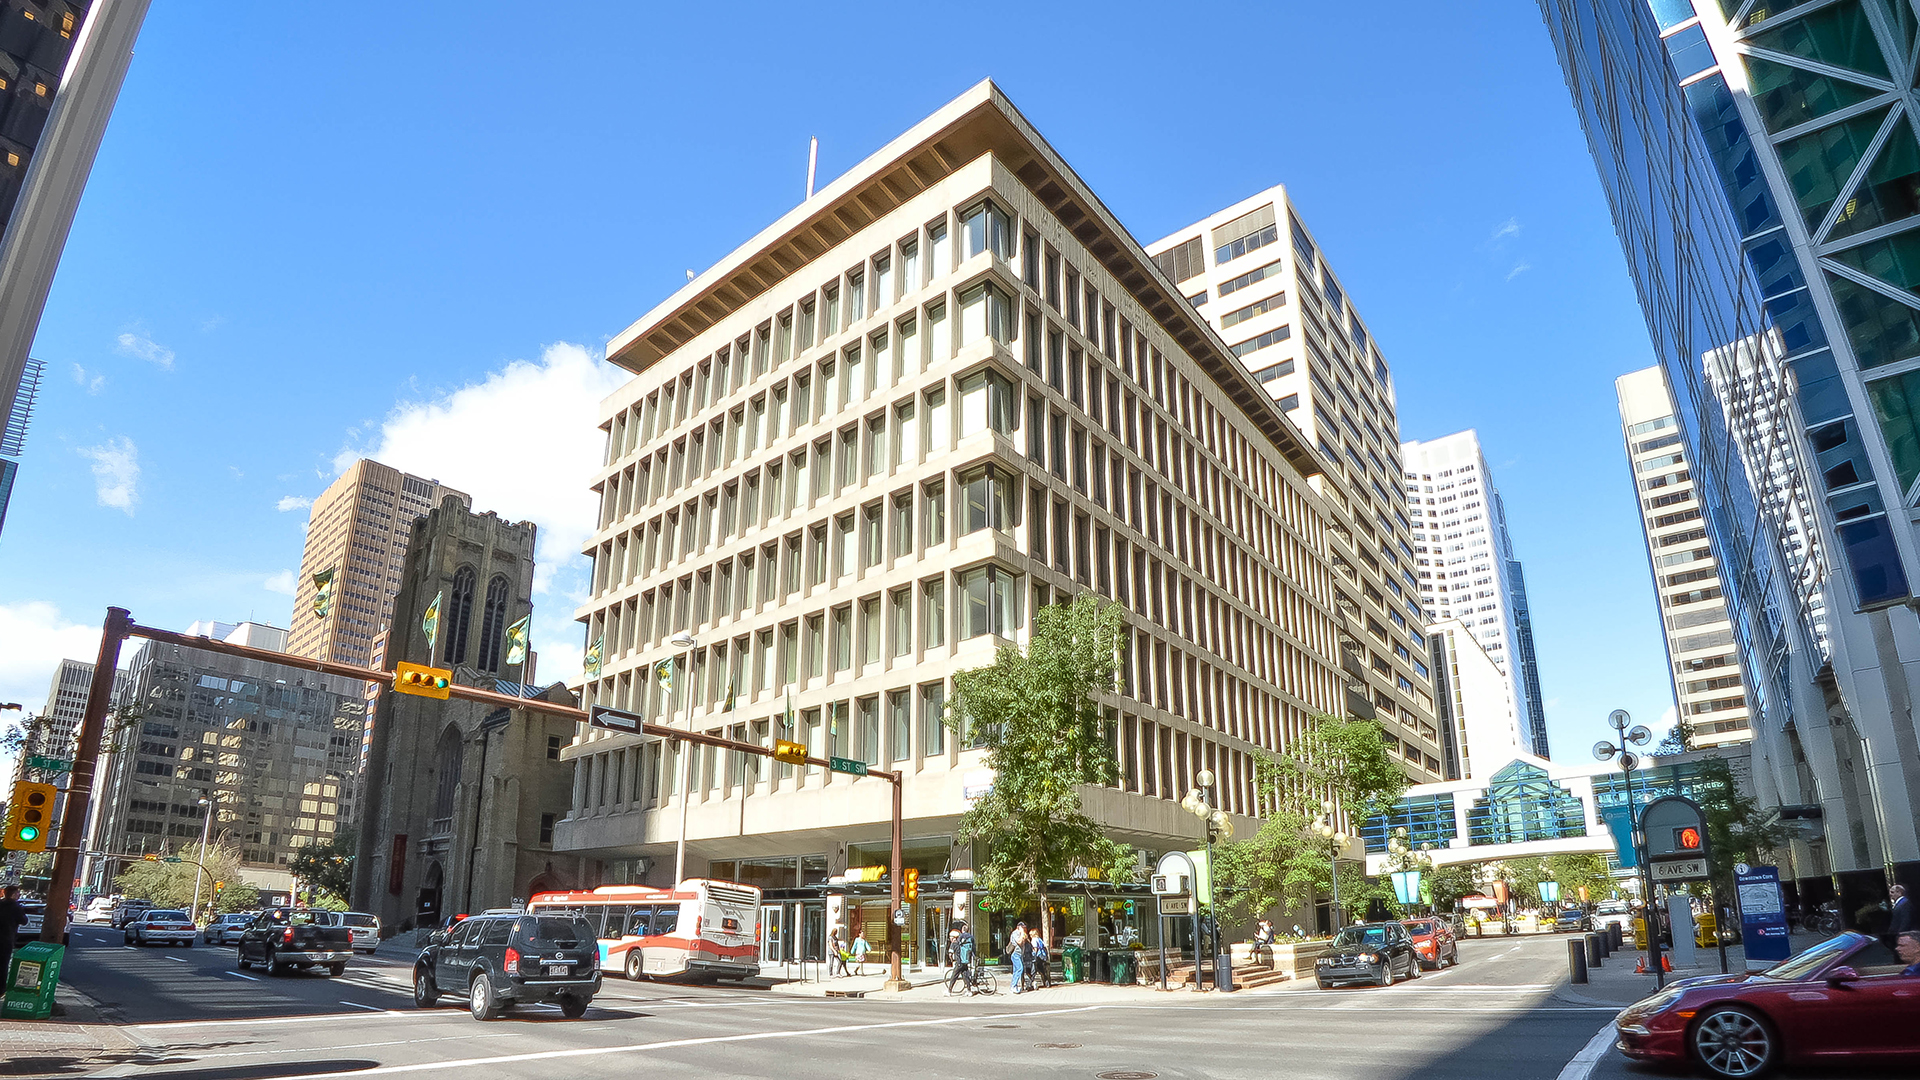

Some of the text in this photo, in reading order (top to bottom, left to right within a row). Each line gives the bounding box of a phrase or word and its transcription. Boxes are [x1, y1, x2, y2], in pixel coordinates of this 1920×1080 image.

[832, 760, 865, 774] 3 ST SW
[844, 865, 887, 882] WAY
[1659, 863, 1699, 876] 6 AVE SW
[24, 945, 53, 953] metro
[7, 1000, 34, 1010] metro
